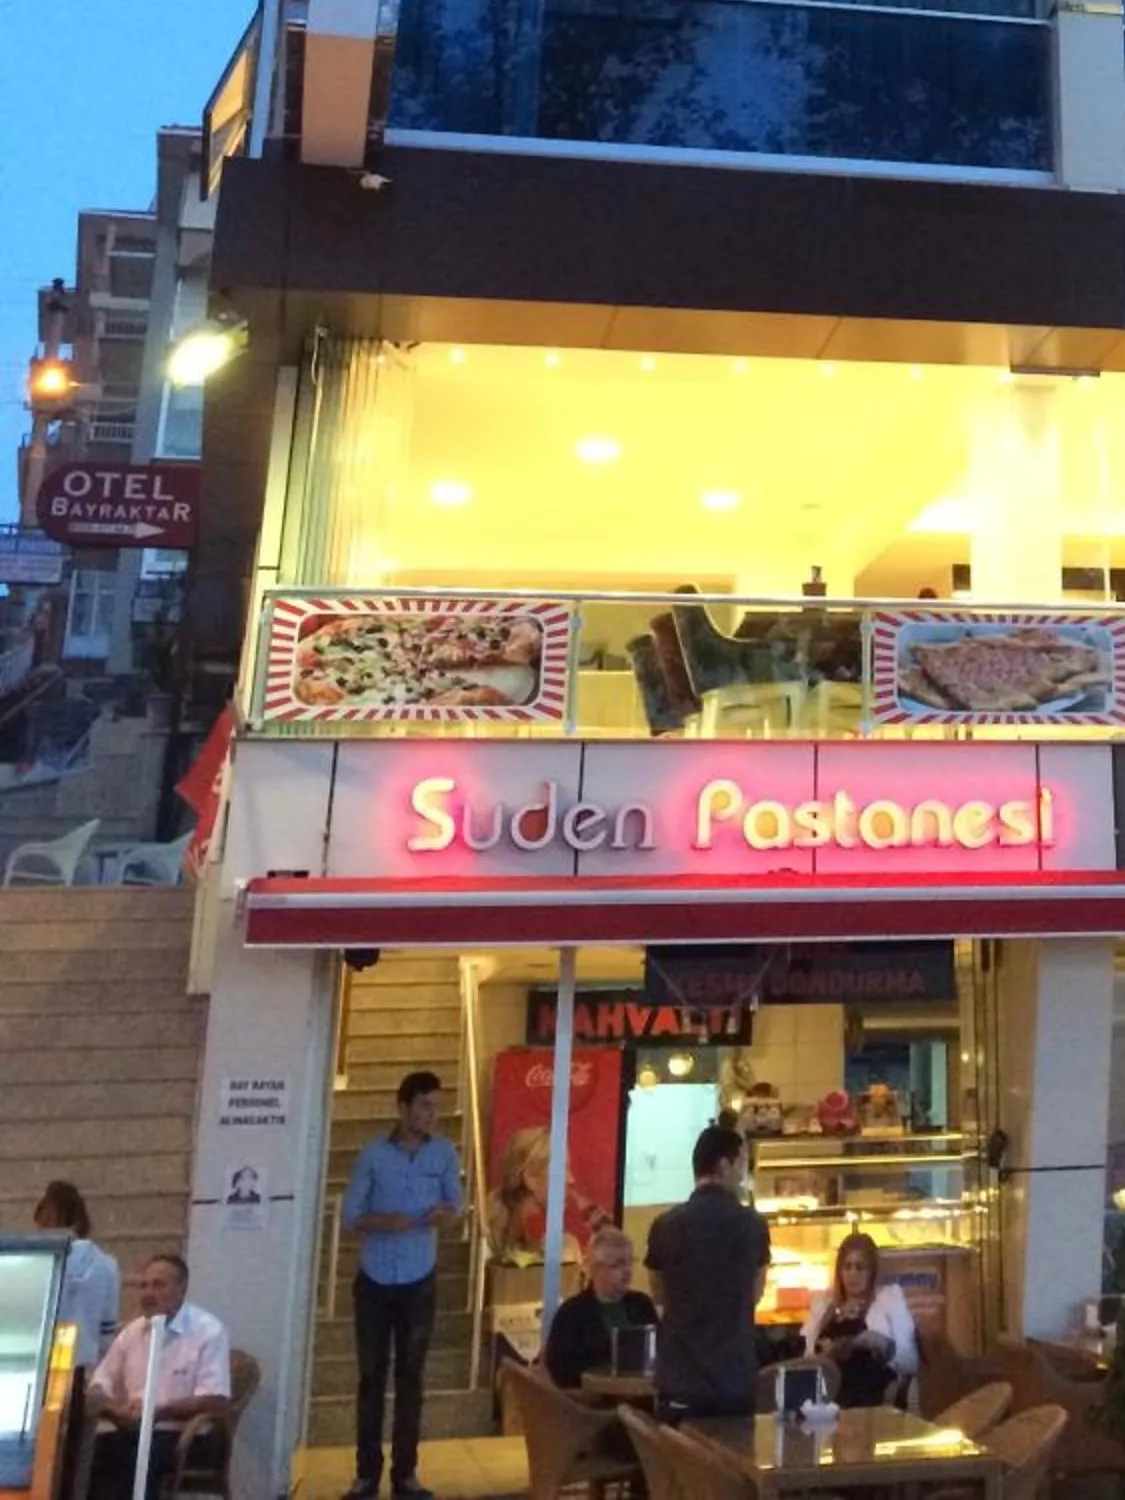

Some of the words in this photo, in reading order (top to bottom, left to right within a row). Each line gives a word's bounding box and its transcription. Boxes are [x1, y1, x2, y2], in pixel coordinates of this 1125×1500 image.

[63, 470, 175, 501] OTEL
[51, 496, 192, 522] BAYRAKTAR
[407, 777, 656, 853] Suden
[691, 777, 1058, 852] Pastanesi
